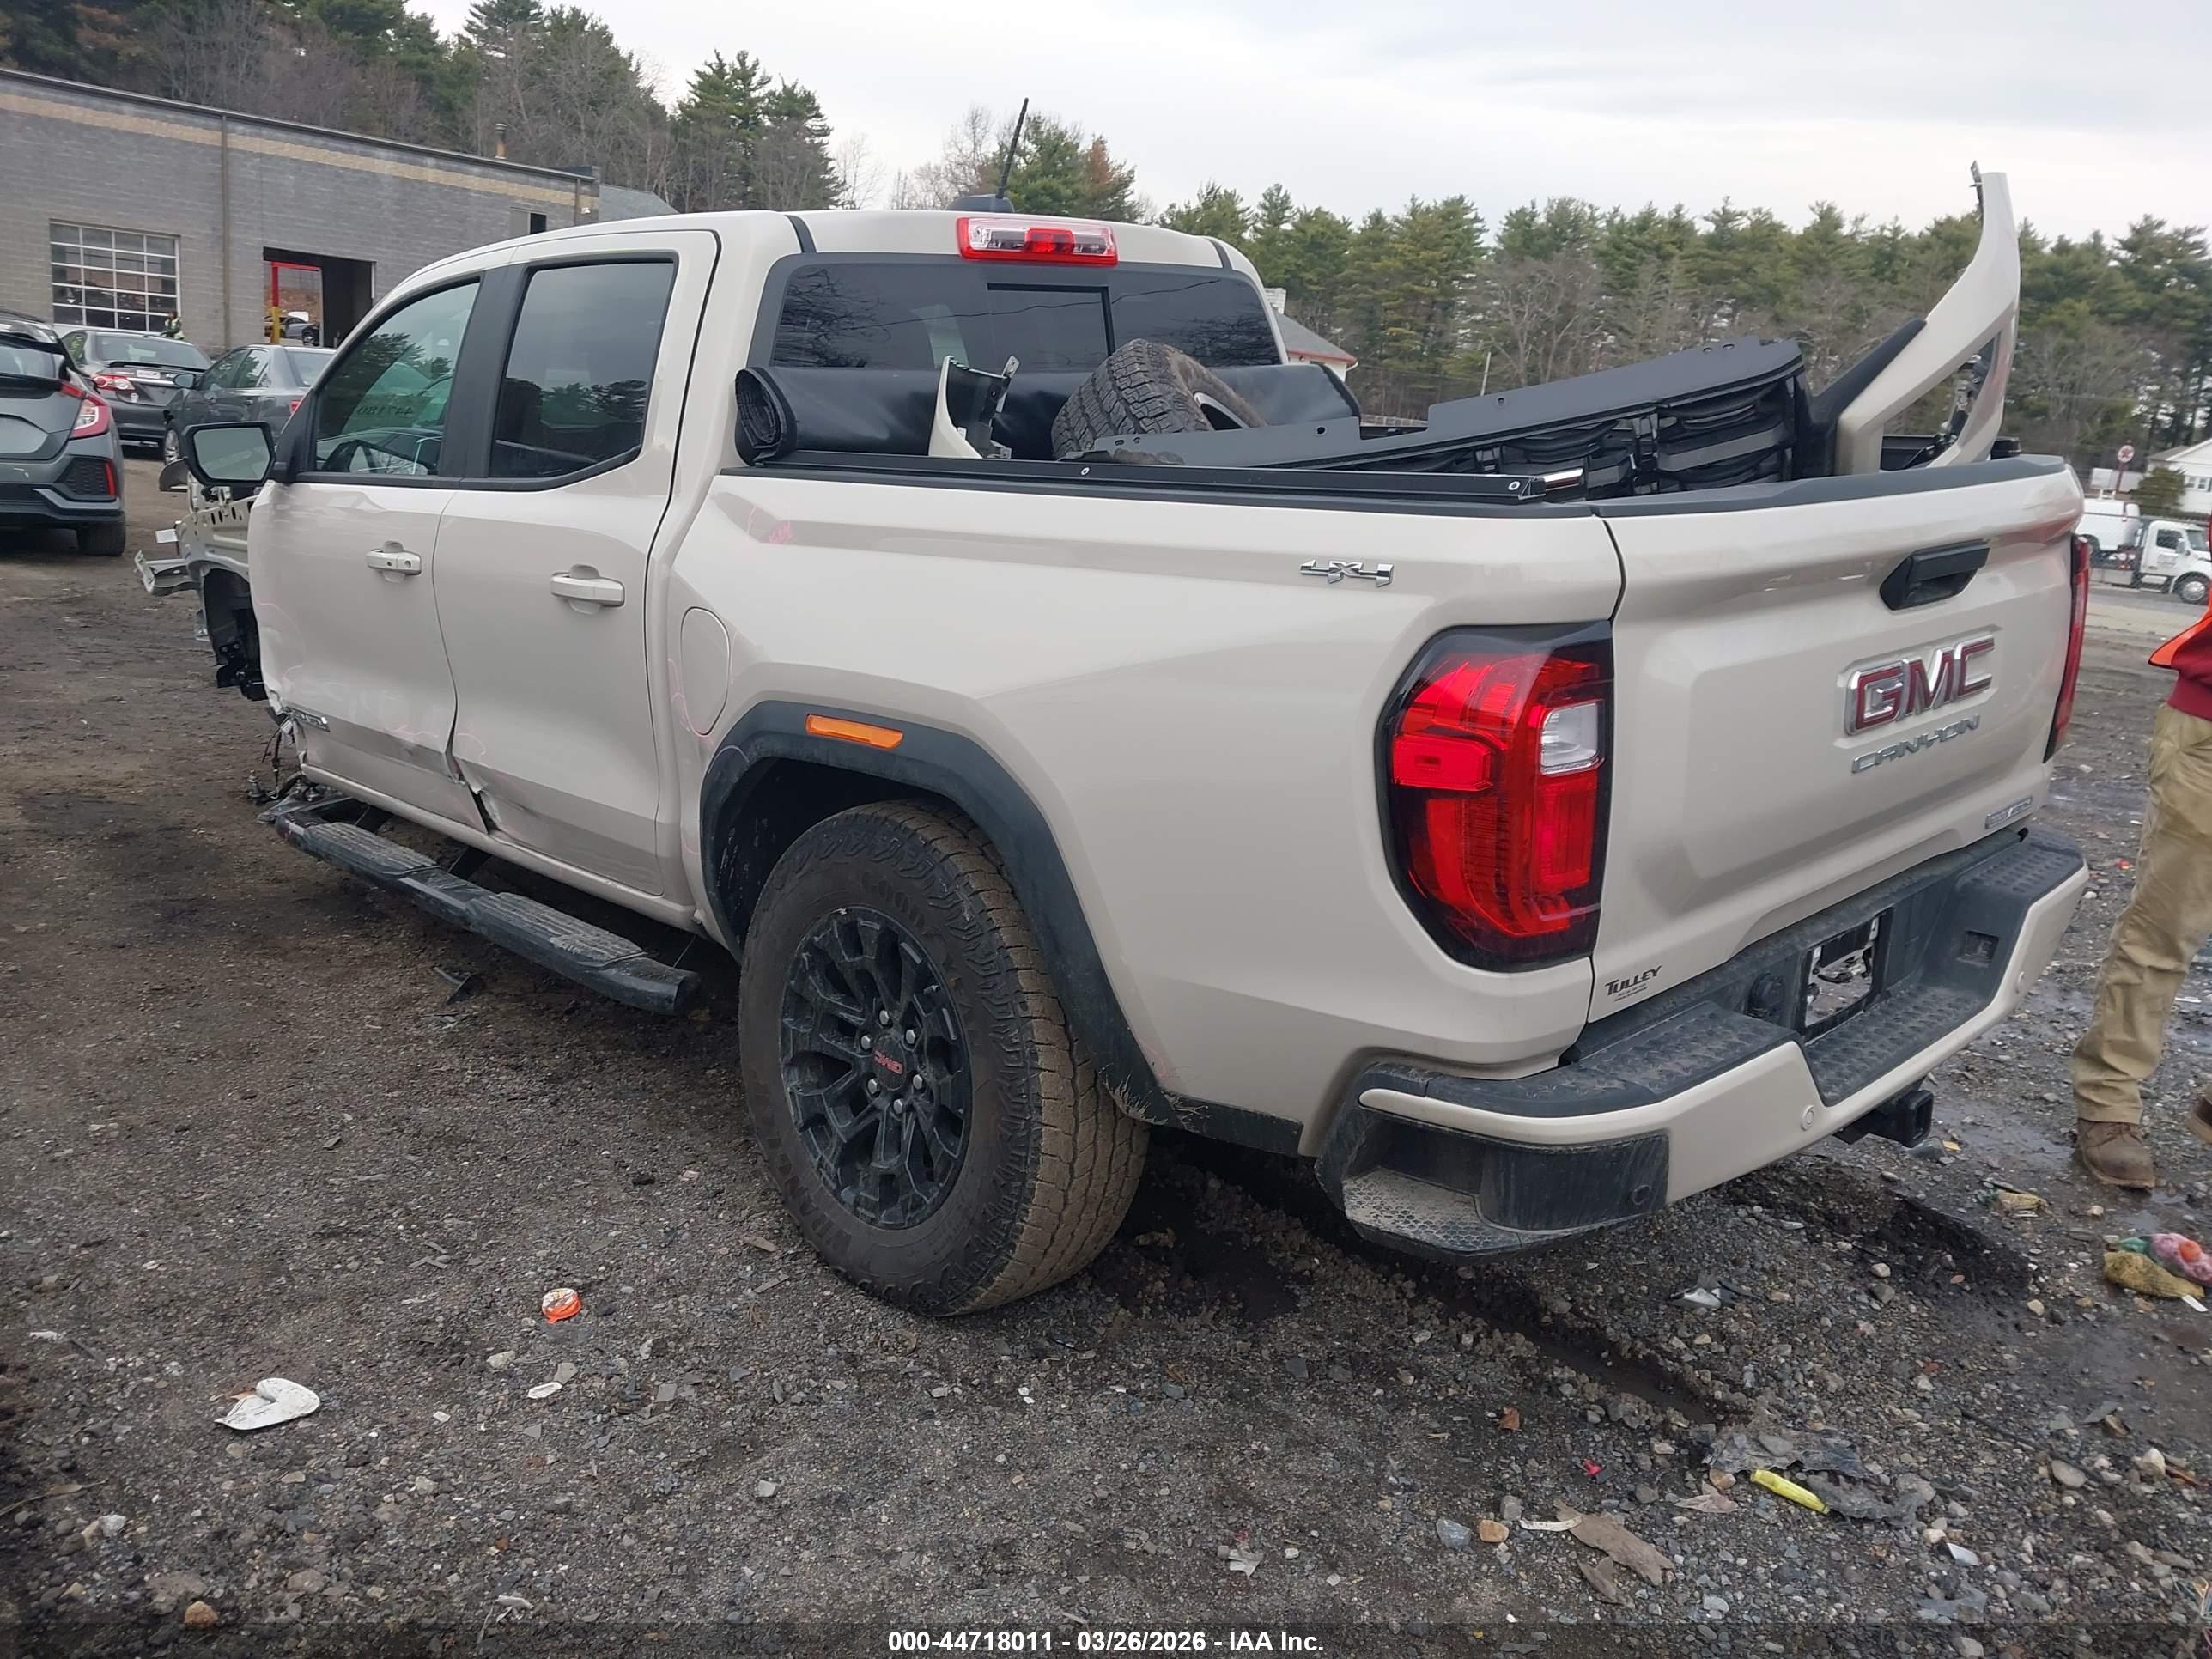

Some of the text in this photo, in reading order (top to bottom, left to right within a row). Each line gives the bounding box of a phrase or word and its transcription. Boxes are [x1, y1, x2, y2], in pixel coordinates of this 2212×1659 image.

[1844, 635, 1995, 736] GMC
[1851, 714, 1980, 774] CANYON
[1604, 963, 1663, 996] TULLEY
[874, 1050, 904, 1075] GMC
